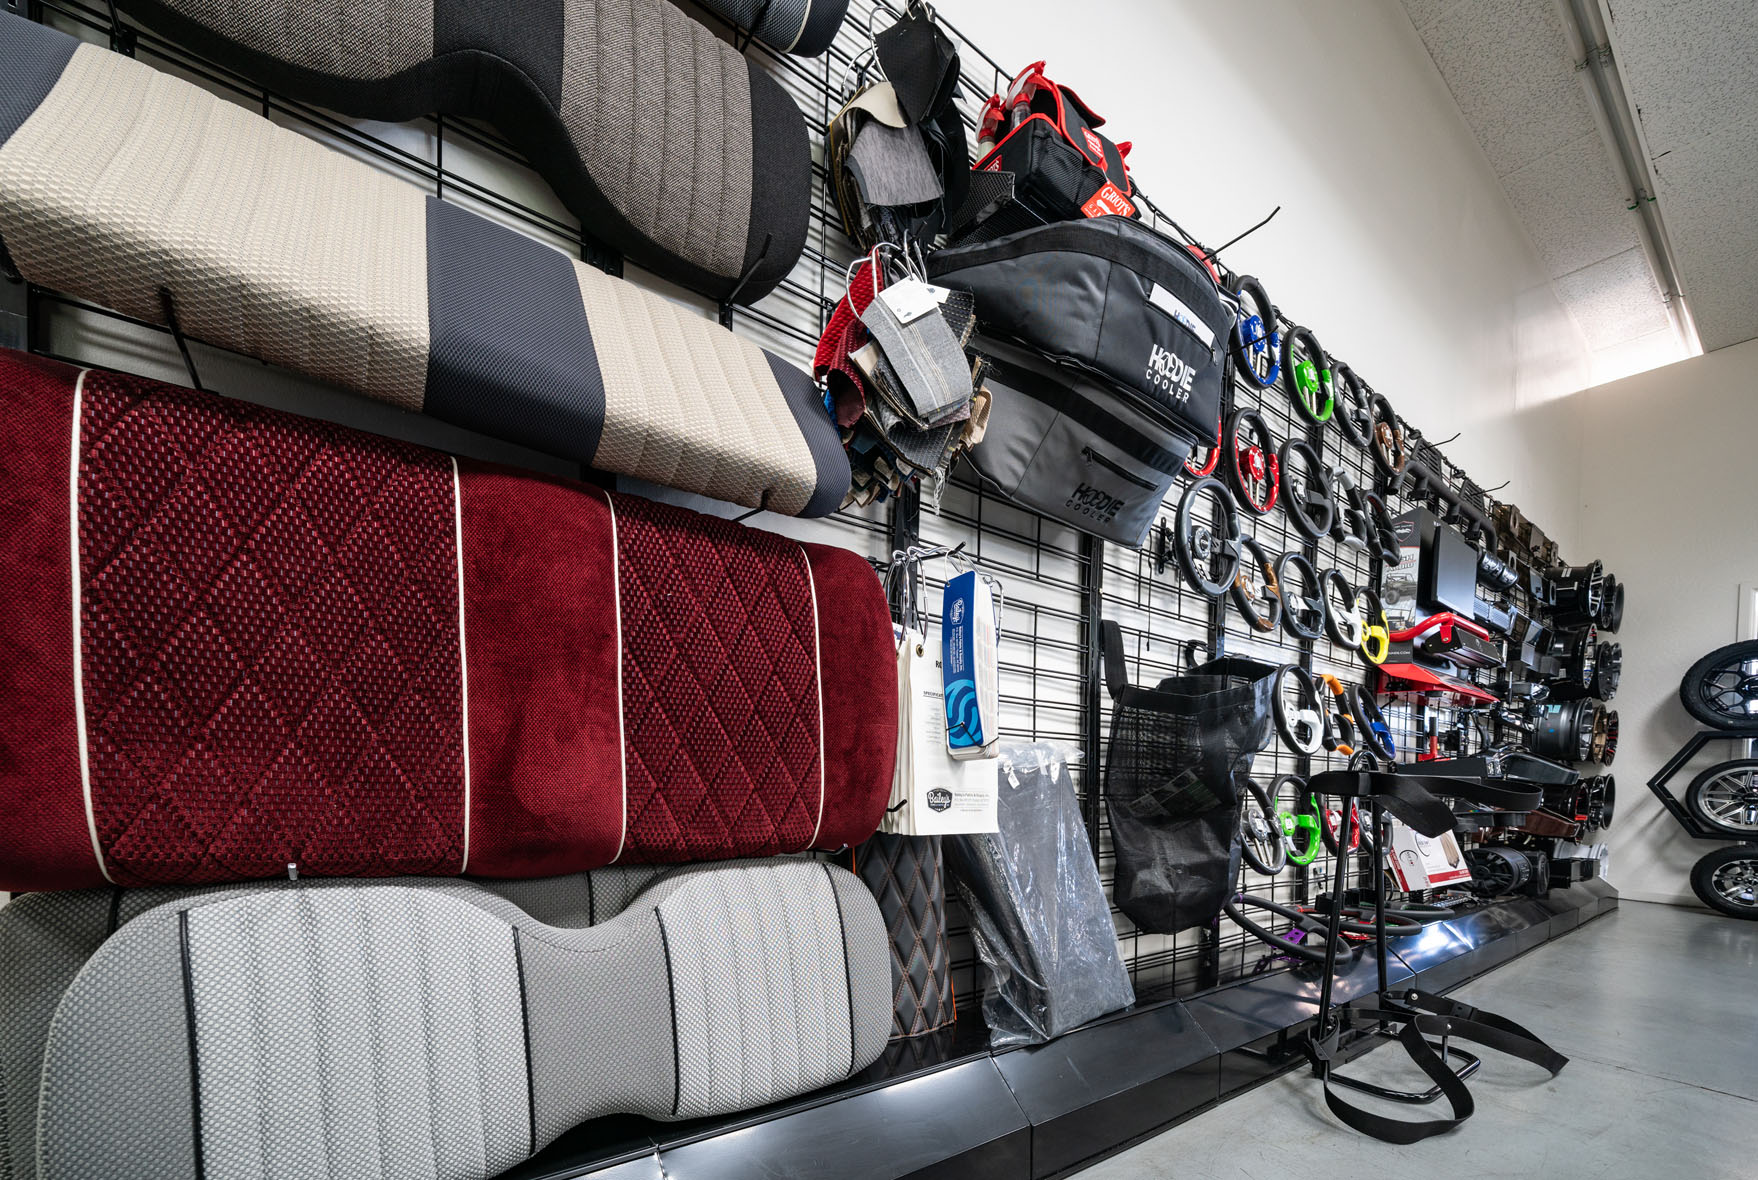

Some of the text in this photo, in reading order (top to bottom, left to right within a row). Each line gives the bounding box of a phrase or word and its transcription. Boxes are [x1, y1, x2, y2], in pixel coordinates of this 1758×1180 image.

[1148, 344, 1196, 392] HOODIE
[1146, 369, 1190, 403] COOLER
[1065, 499, 1111, 524] COOLER
